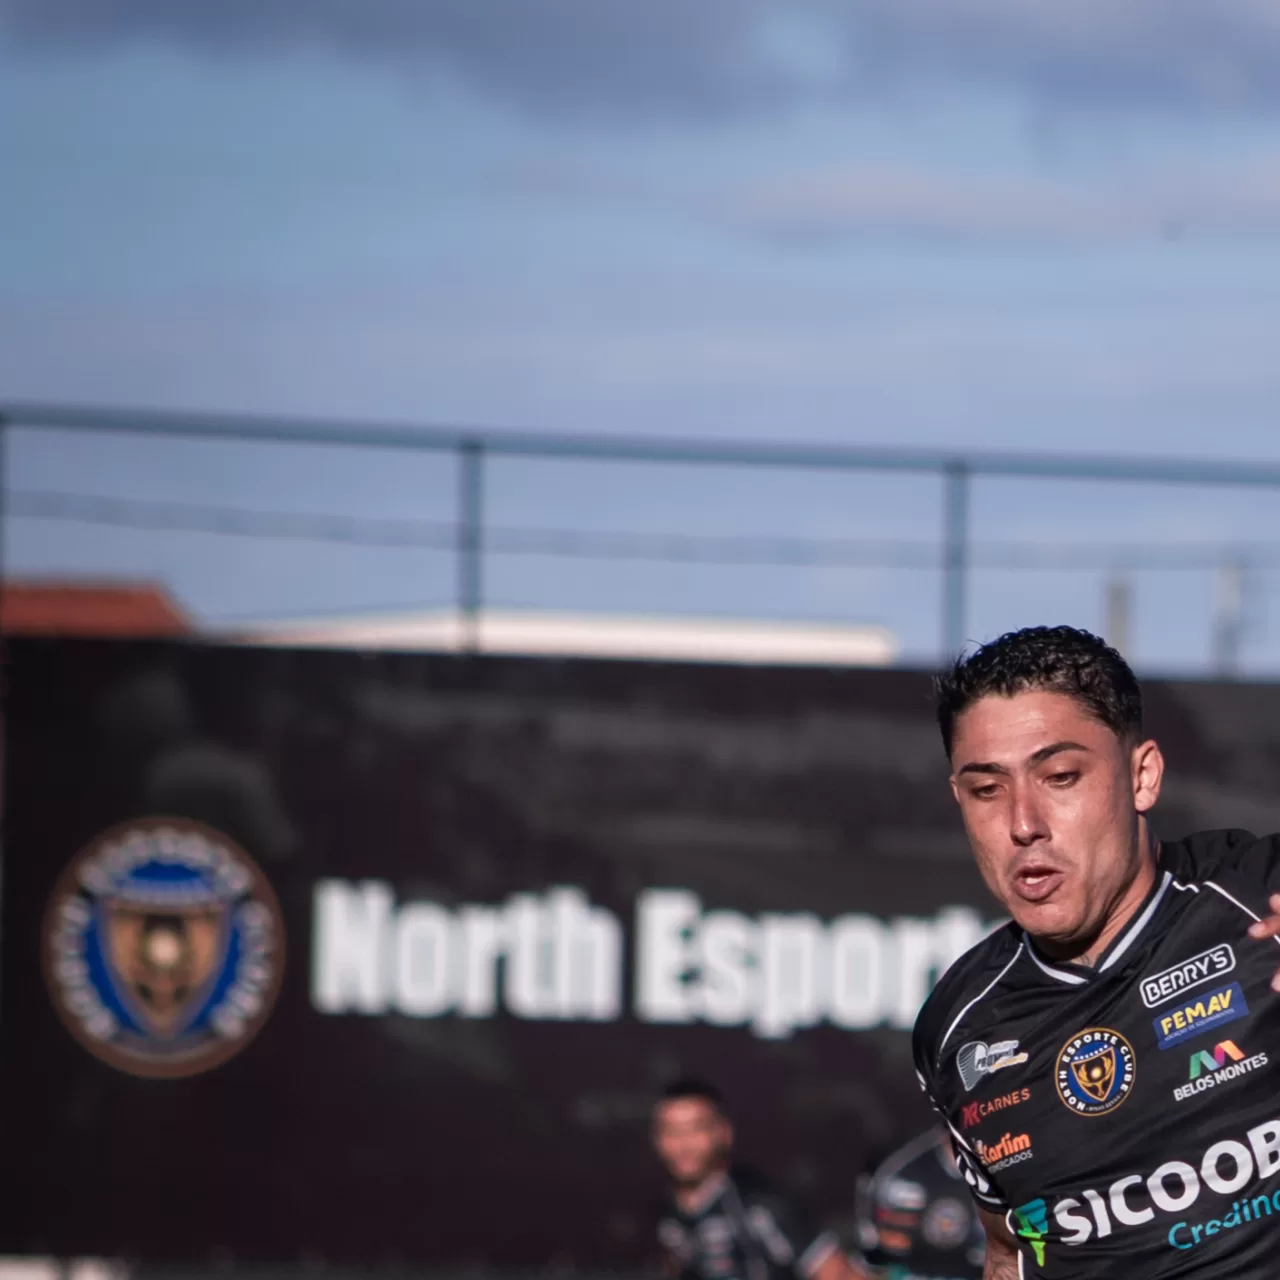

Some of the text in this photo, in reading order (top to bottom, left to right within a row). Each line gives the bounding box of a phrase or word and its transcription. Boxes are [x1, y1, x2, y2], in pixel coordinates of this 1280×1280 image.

[312, 877, 622, 1021] North
[634, 886, 988, 1040] Esport
[1145, 950, 1228, 1002] BERRY'S
[1160, 989, 1232, 1036] FEMAV
[1061, 1032, 1118, 1063] ESPORTE
[1120, 1046, 1133, 1092] CLUBE
[1059, 1070, 1086, 1111] NORTH
[1173, 1052, 1268, 1101] BELOS MONTES
[979, 1088, 1031, 1116] CARNES
